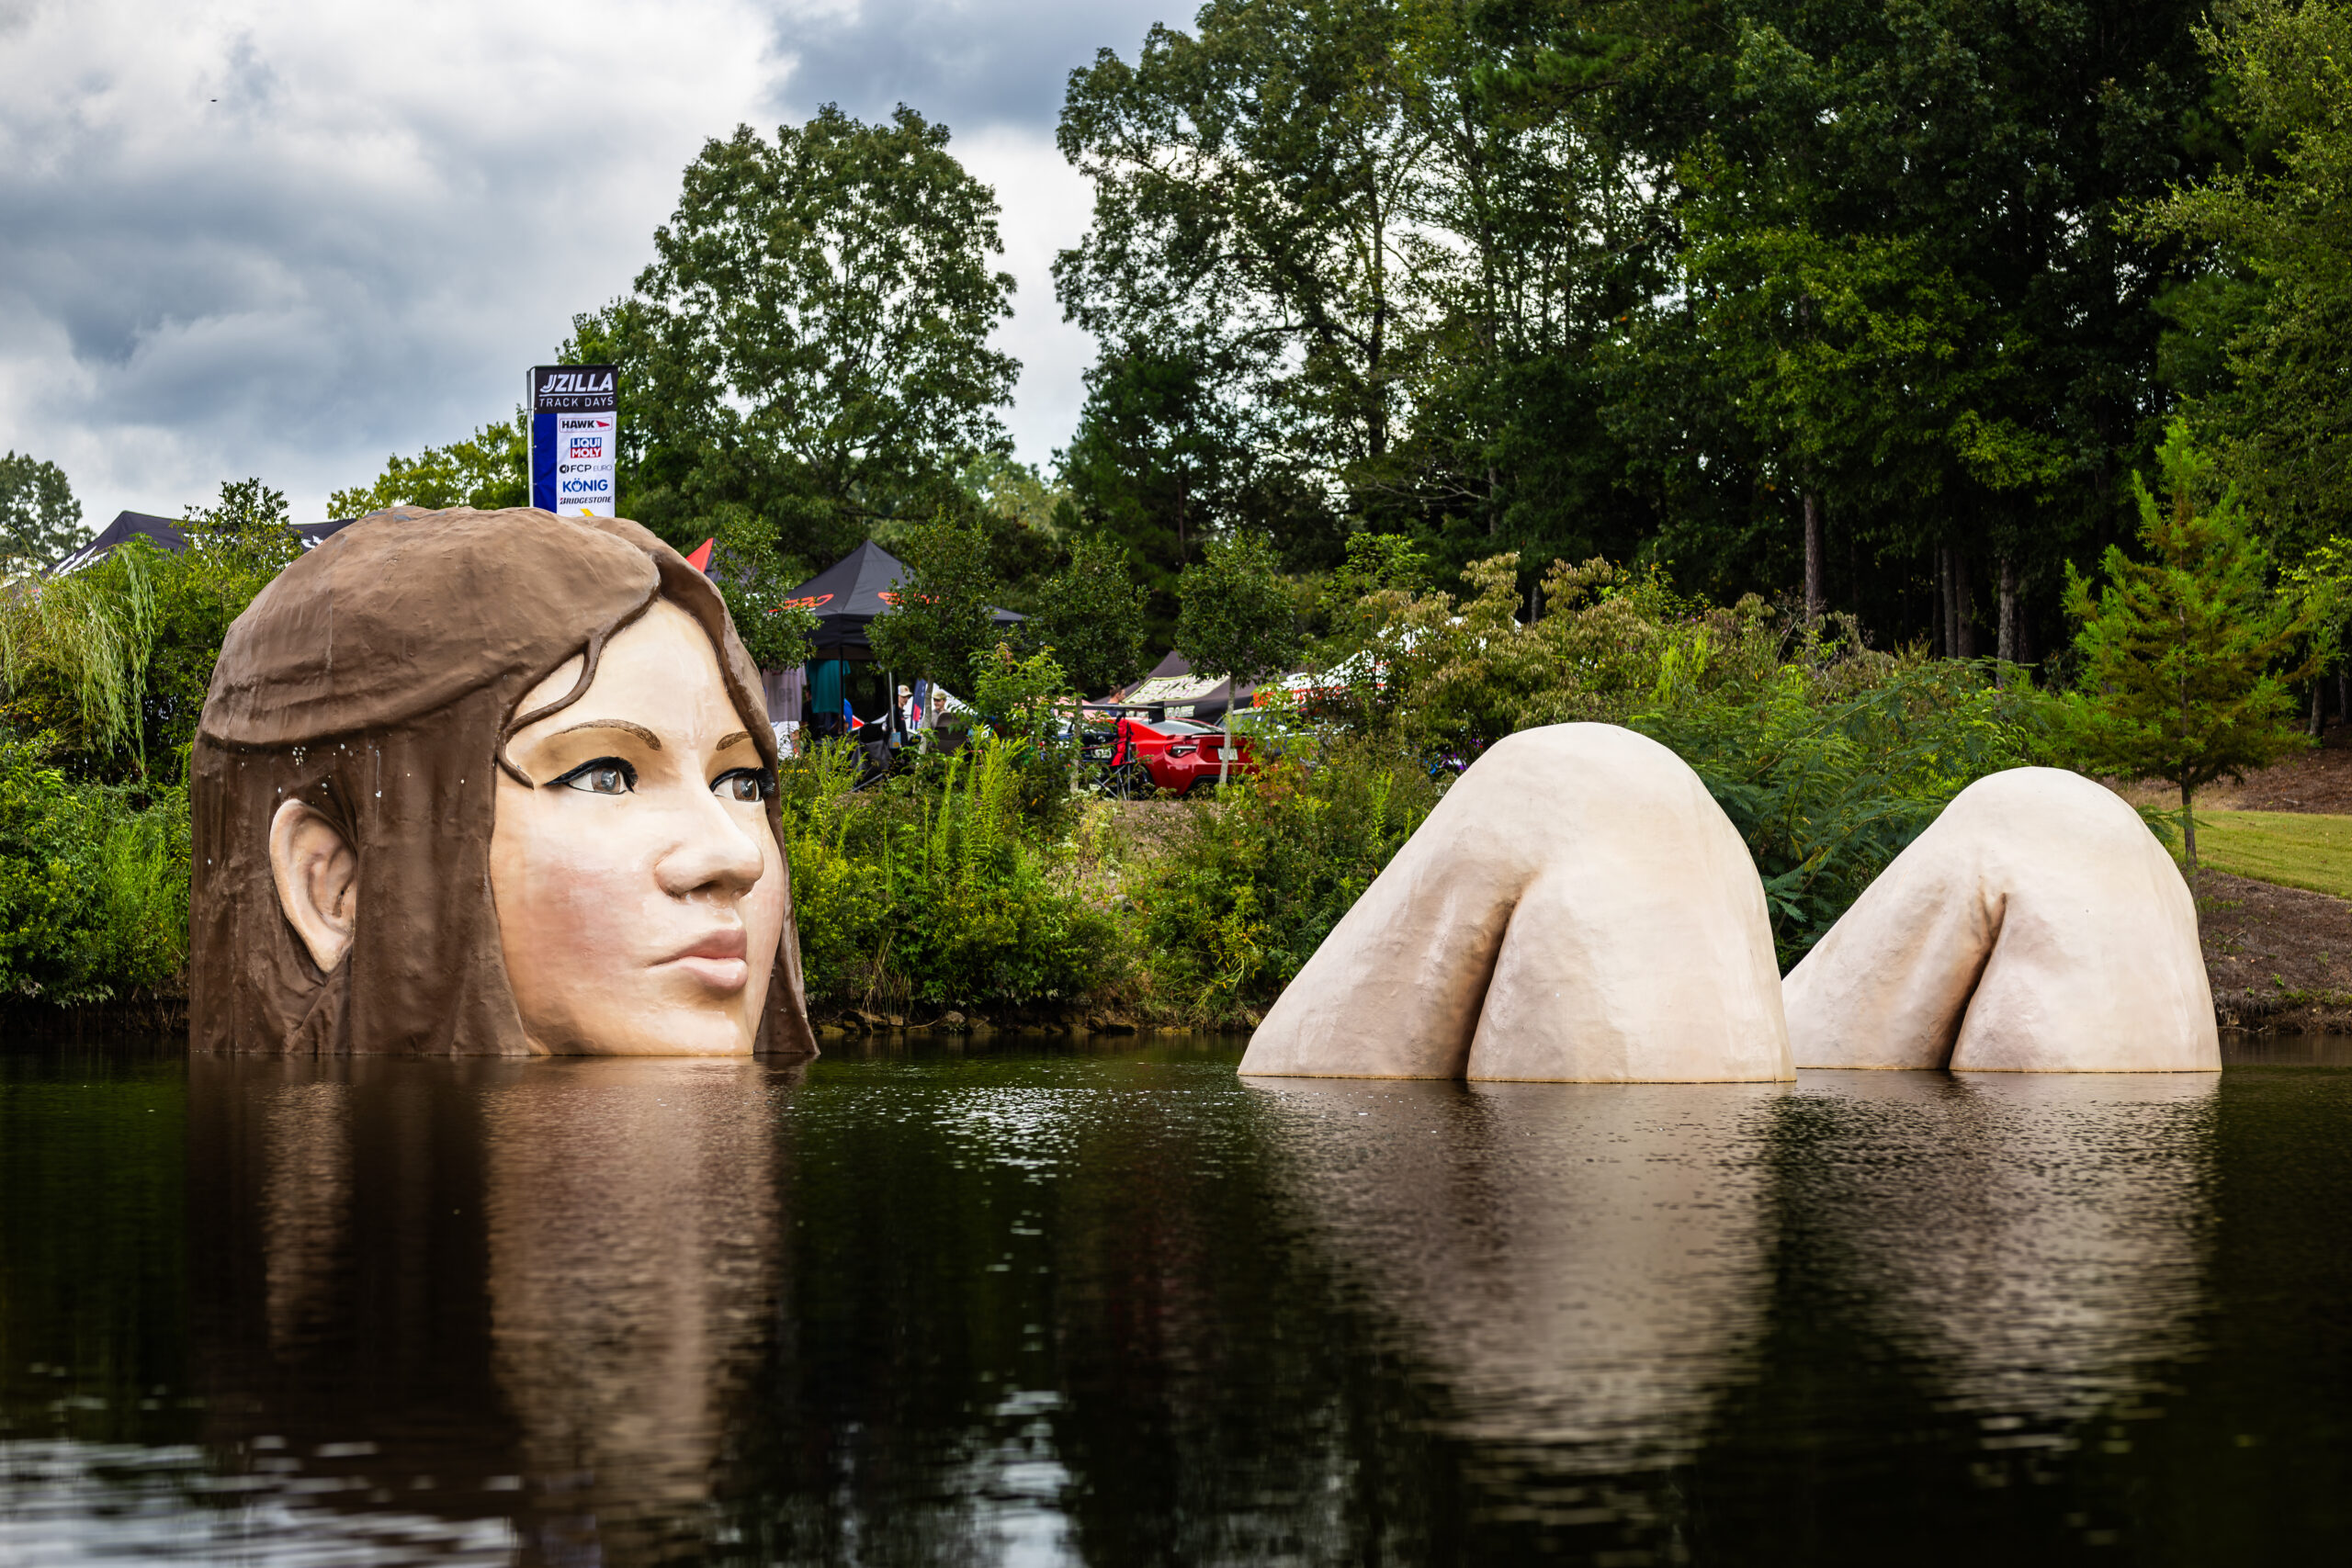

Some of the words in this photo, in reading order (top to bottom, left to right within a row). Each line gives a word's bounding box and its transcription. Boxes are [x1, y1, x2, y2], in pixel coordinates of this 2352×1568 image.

[539, 373, 613, 392] JZILLA
[539, 398, 579, 407] TRACK
[584, 396, 614, 407] DAYS
[561, 420, 595, 429] HAWK
[571, 438, 601, 448] LIQUI
[571, 448, 601, 457] MOLY
[571, 464, 592, 472] FCP
[562, 478, 608, 492] KÖNIG
[560, 496, 612, 504] BRIDGESTONE
